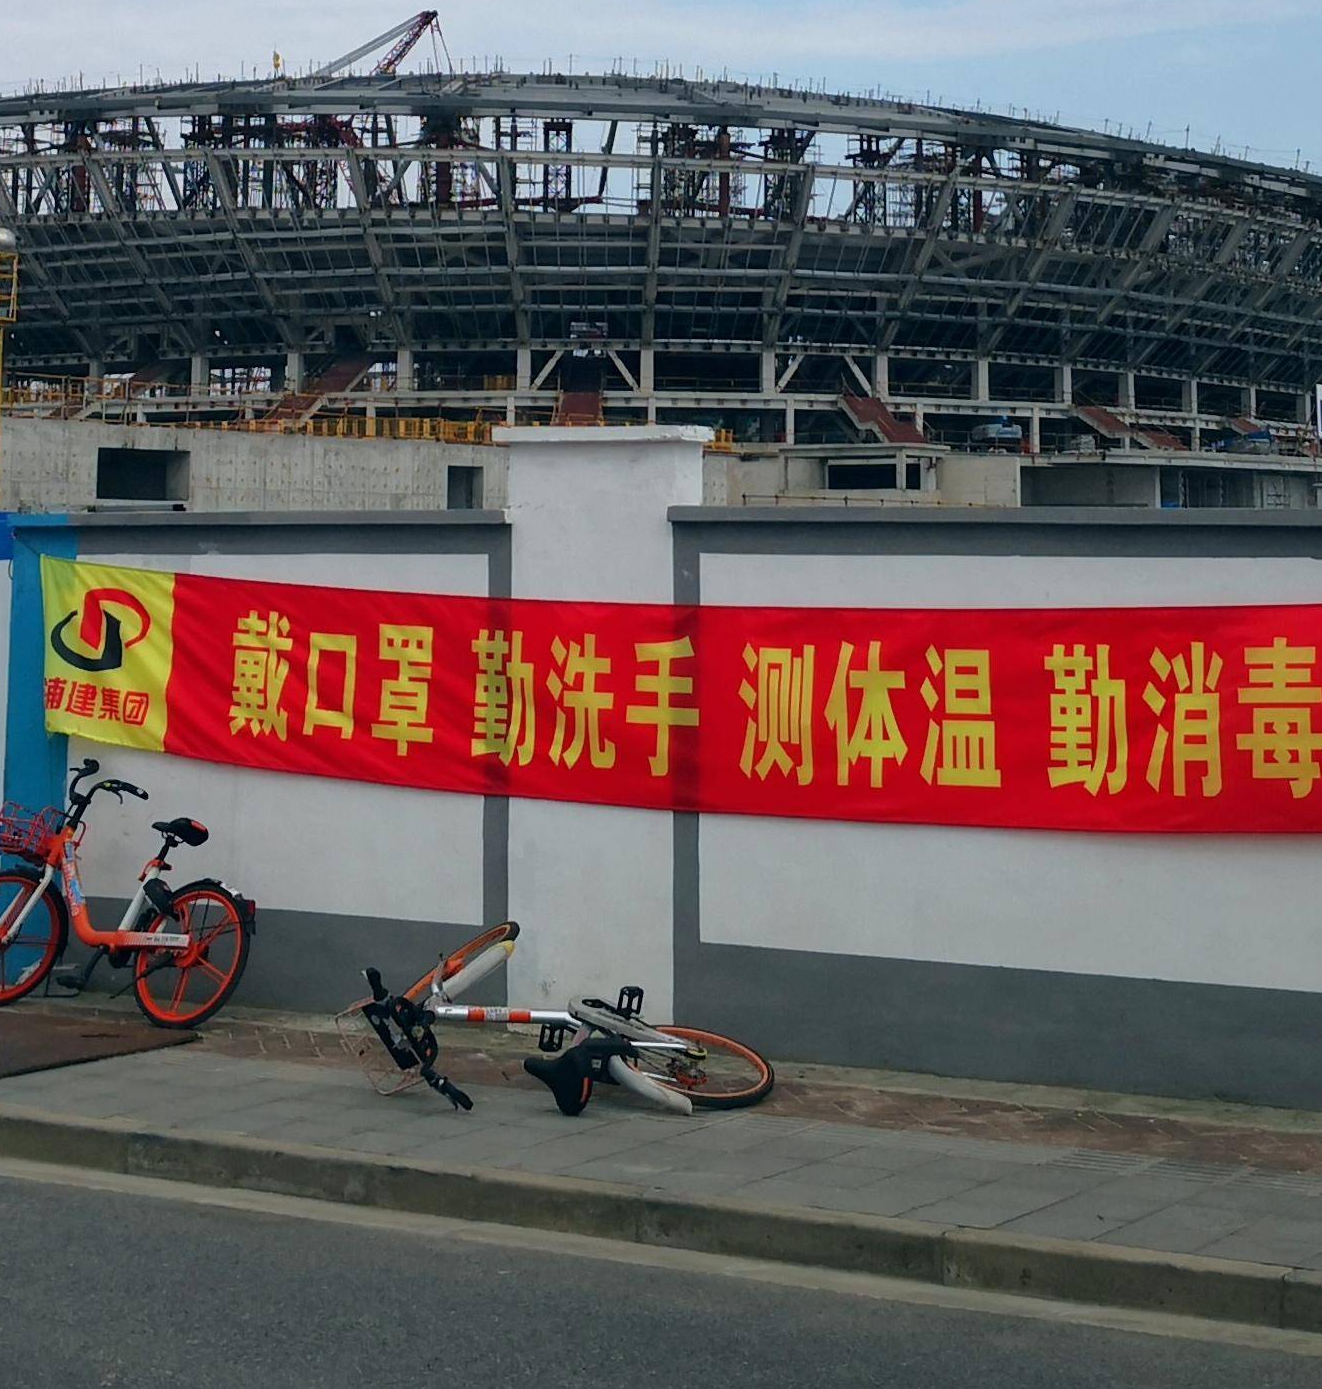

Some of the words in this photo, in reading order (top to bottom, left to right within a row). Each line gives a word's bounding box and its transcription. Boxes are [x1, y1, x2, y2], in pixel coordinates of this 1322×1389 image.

[44, 676, 150, 727] 浦建集团
[229, 611, 434, 756] 戴口罩
[471, 629, 699, 777] 勤洗手
[739, 641, 1002, 788] 测体温
